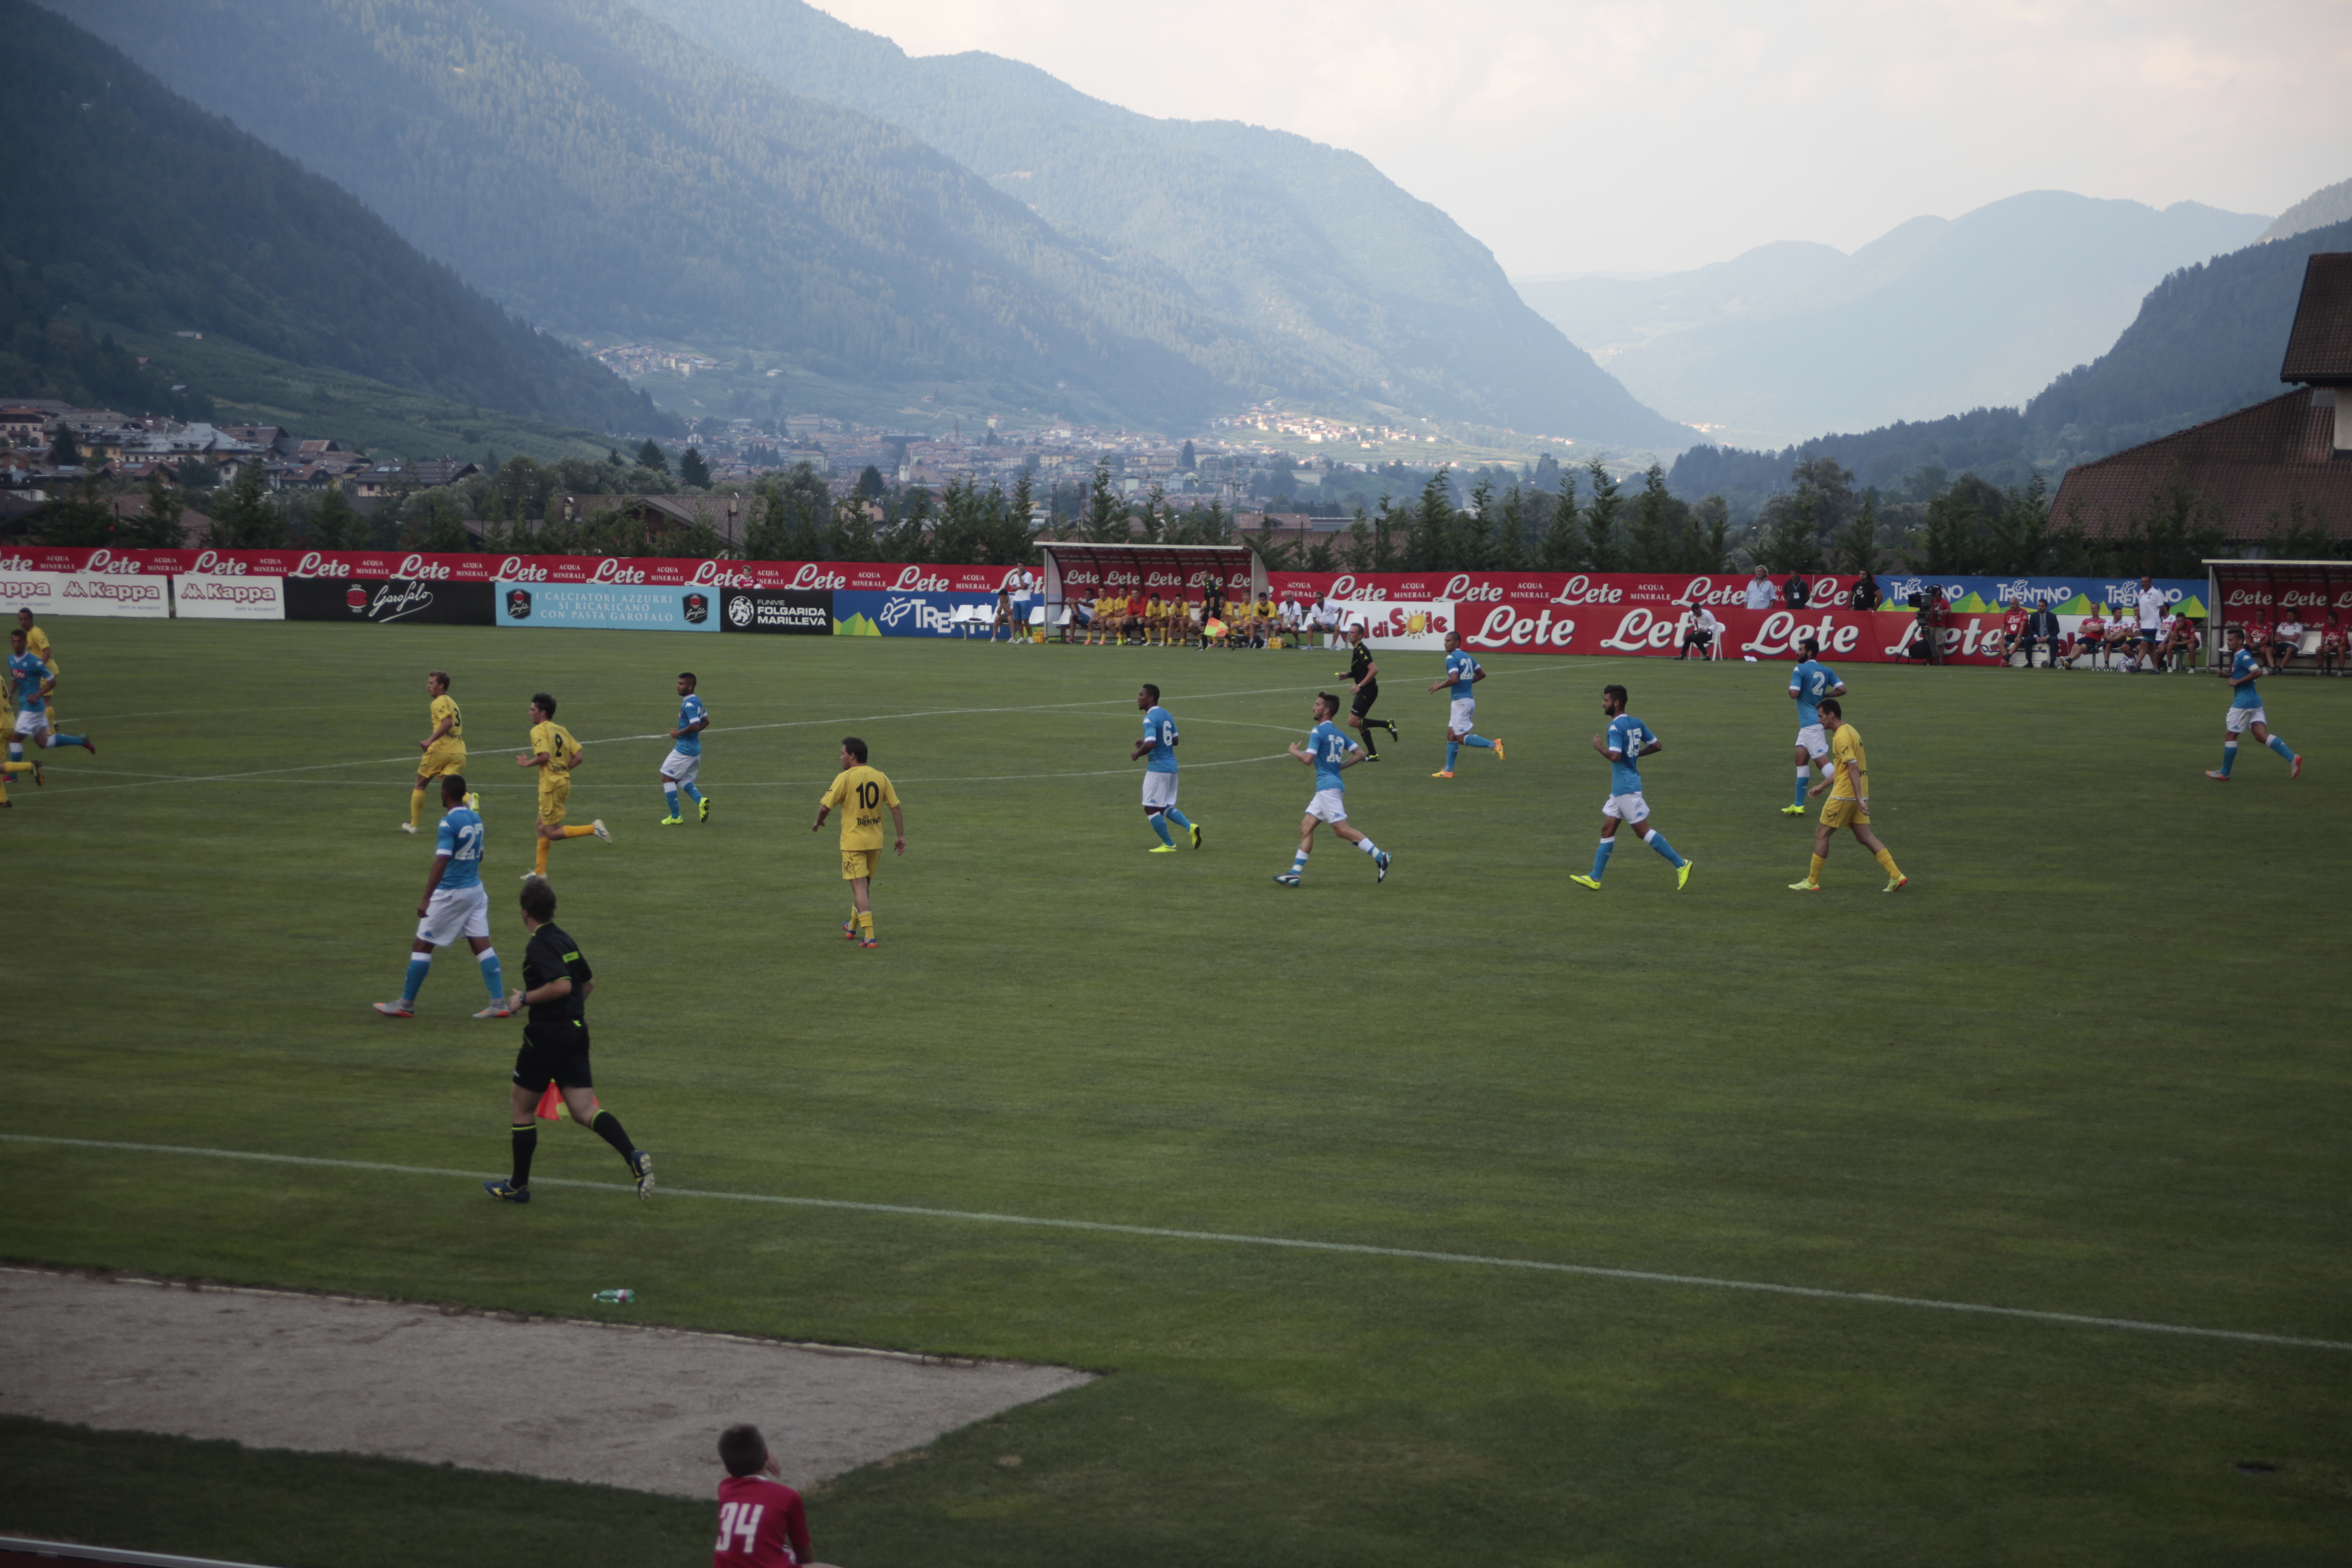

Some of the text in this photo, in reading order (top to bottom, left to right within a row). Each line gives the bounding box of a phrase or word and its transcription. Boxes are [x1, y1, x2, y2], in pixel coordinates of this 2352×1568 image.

[0, 550, 33, 571] ete
[76, 549, 141, 574] Lete
[184, 551, 247, 575] Lete
[288, 552, 351, 578] Lete
[389, 554, 450, 580] Lete
[489, 556, 547, 582] Lete
[586, 558, 645, 584] Lete
[684, 561, 744, 586] Lete
[784, 563, 846, 591] Lete
[887, 565, 949, 592] Lete
[1063, 570, 1100, 585] Lete
[1104, 571, 1140, 586] Lete
[1145, 572, 1181, 587] Lete
[1228, 573, 1251, 588] Le
[0, 582, 51, 598] ppa
[89, 582, 160, 601] Kappa
[207, 583, 276, 603] Kappa
[535, 592, 673, 603] I CALCIATORI AZZURRI
[1325, 575, 1387, 601] Lete
[1432, 574, 1504, 602] Lete
[1550, 575, 1623, 606] Lete
[1671, 576, 1746, 606] Lete
[1997, 584, 2071, 604] TRENTINO
[2224, 589, 2272, 606] Lete
[2277, 591, 2327, 607] Lete
[369, 581, 433, 623] Garofalo
[559, 601, 650, 612] SI RICARICANO
[757, 606, 826, 616] FOLGARIDA
[540, 610, 673, 622] CON PASTA GAROFALO
[757, 616, 826, 626] MARILLEVA
[1467, 606, 1575, 647] Lete
[1372, 621, 1389, 637] di
[1600, 609, 1710, 651] Let
[1741, 612, 1859, 655] Lete
[1460, 658, 1473, 680] 21
[1812, 671, 1825, 695] 2
[454, 707, 461, 727] 3
[555, 733, 562, 757] 2
[1163, 720, 1172, 746] 6
[1627, 728, 1642, 757] 15
[1326, 735, 1345, 763] 13
[856, 781, 879, 809] 10
[715, 1502, 764, 1553] 34
